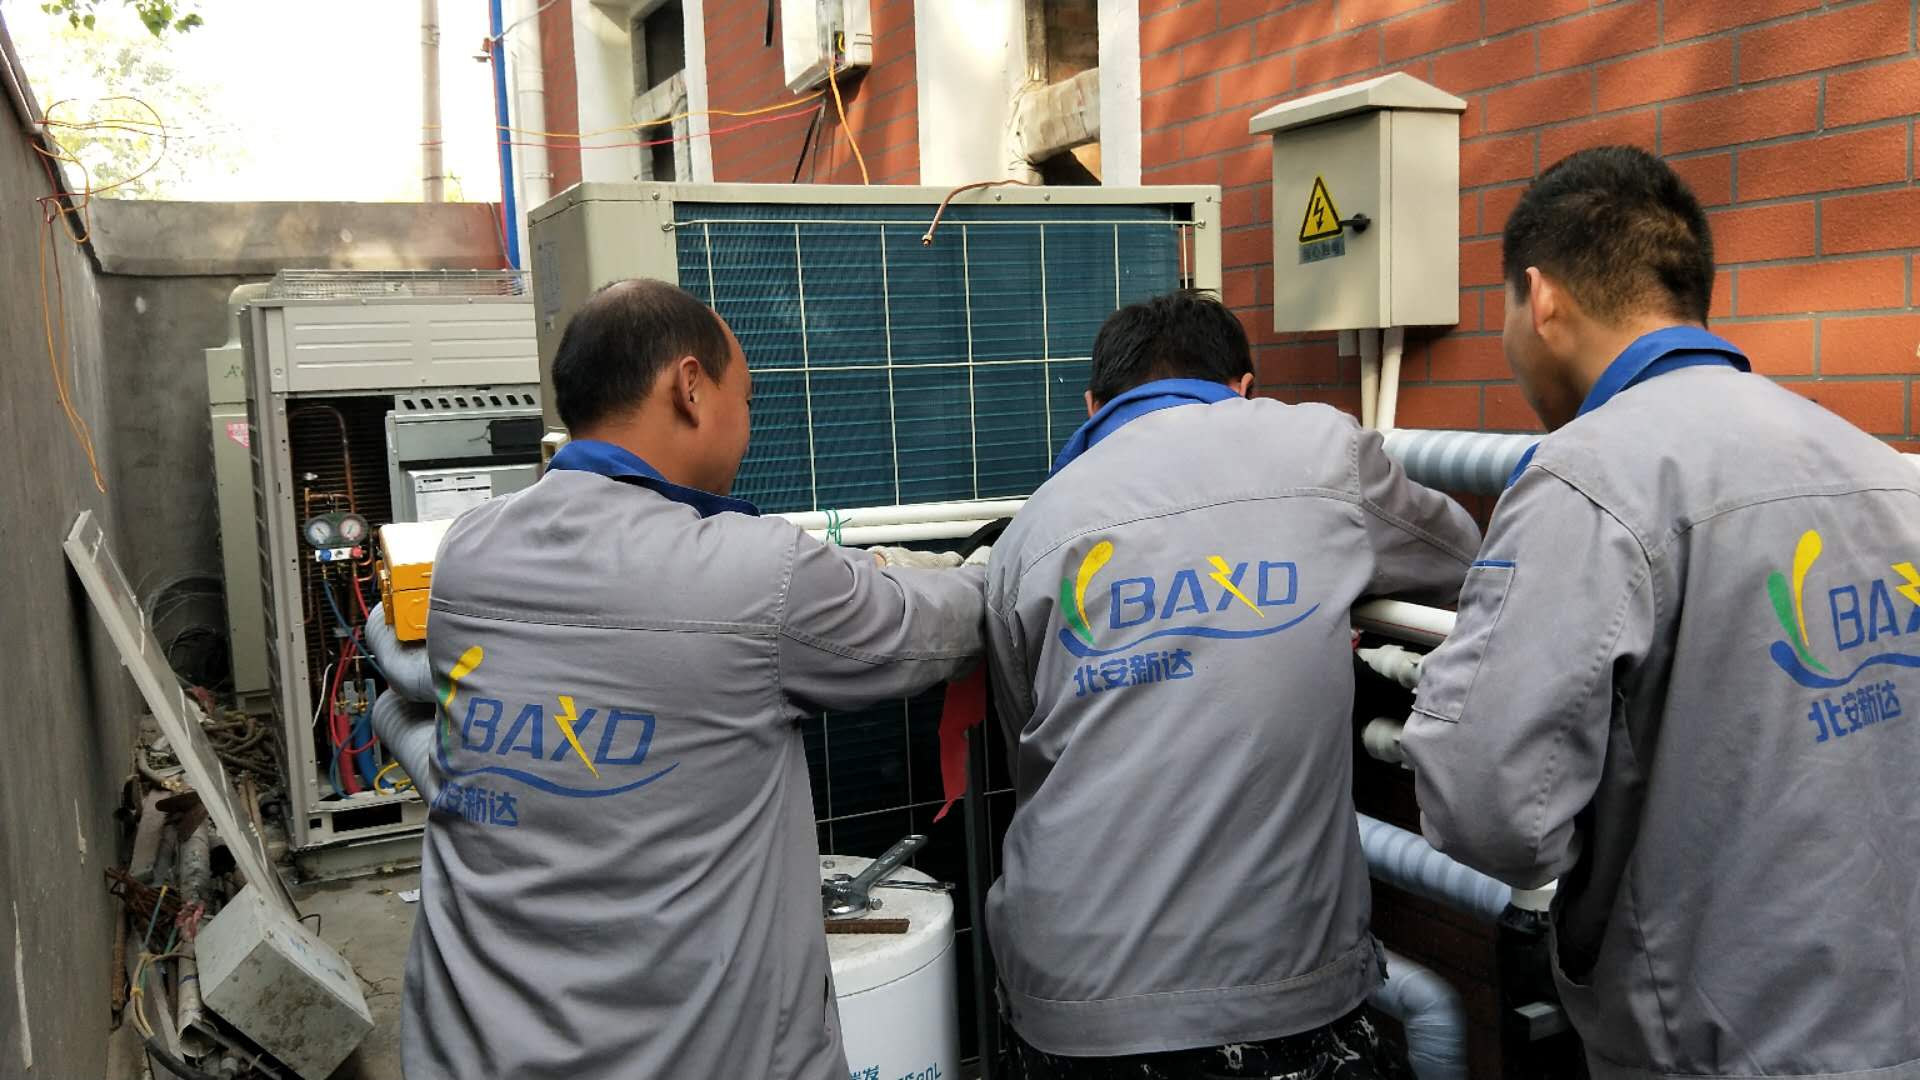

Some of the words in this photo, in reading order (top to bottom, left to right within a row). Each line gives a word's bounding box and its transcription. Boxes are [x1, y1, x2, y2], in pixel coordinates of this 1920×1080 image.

[1109, 555, 1298, 629] BAXD
[1073, 648, 1194, 697] 北安新达
[462, 695, 656, 778] BAXD
[1808, 679, 1901, 742] 北安新达
